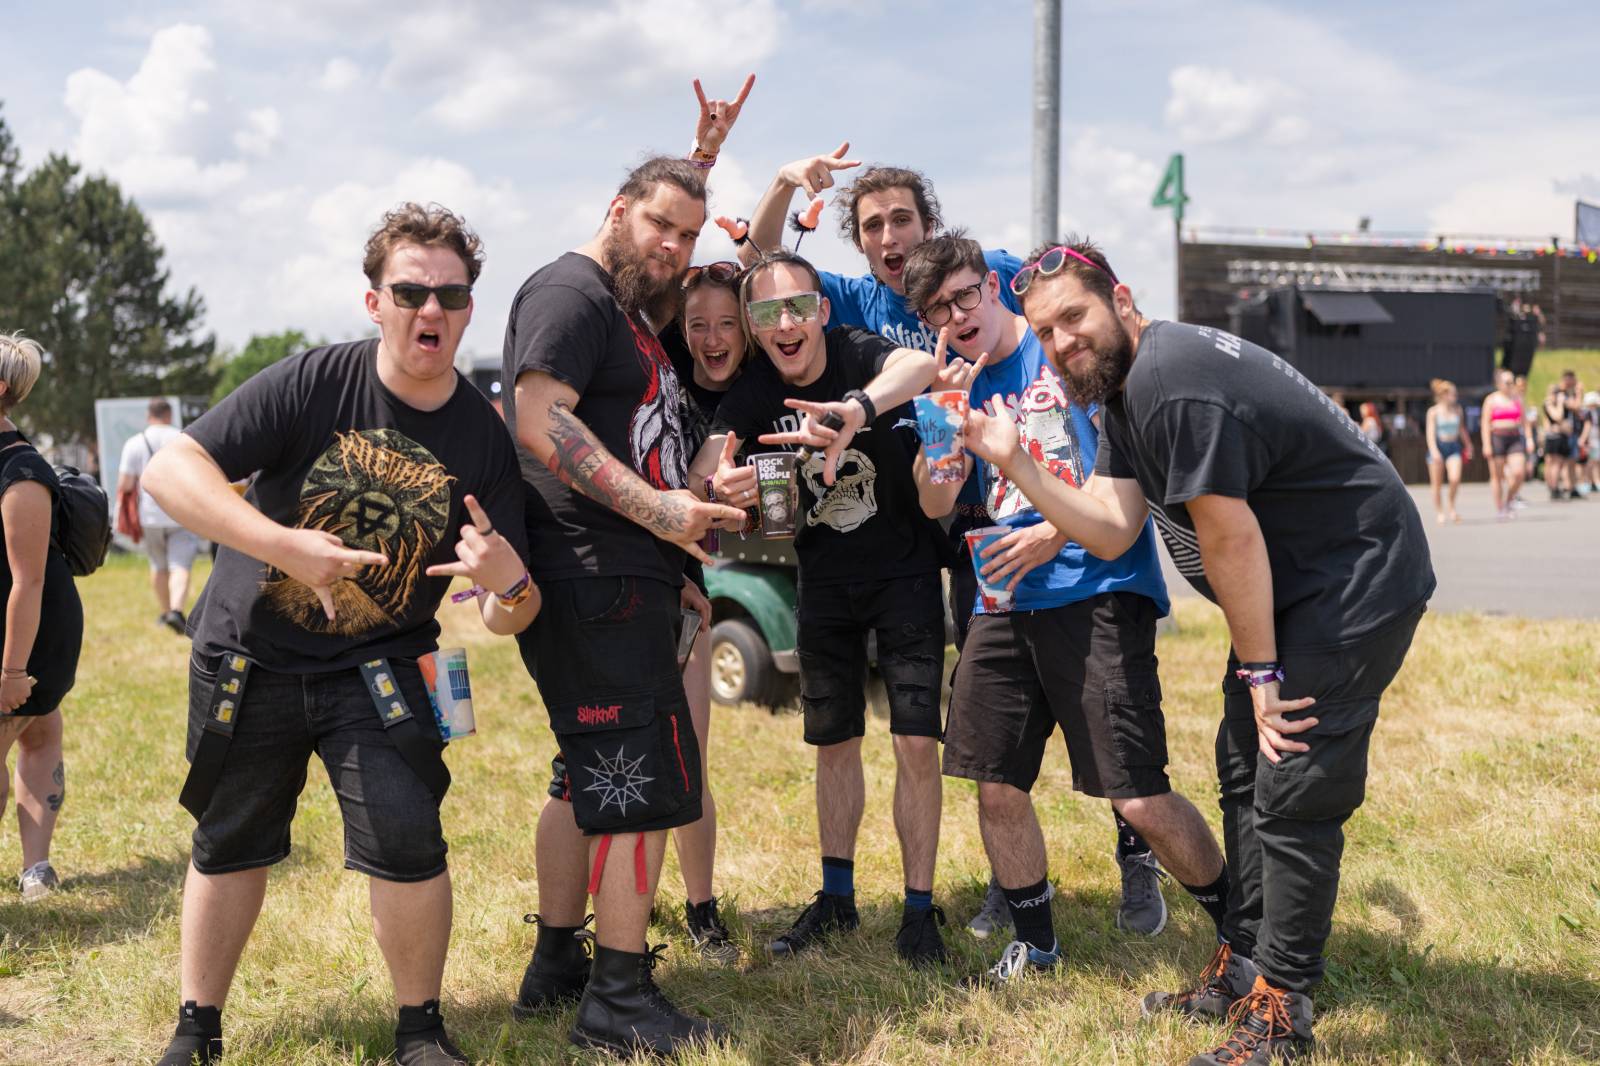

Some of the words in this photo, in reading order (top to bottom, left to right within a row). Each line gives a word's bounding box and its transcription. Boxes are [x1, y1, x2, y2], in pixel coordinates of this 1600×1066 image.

[1151, 152, 1190, 221] 4
[757, 458, 784, 467] ROCK
[759, 465, 777, 473] FOR
[760, 471, 791, 480] PEOPLE
